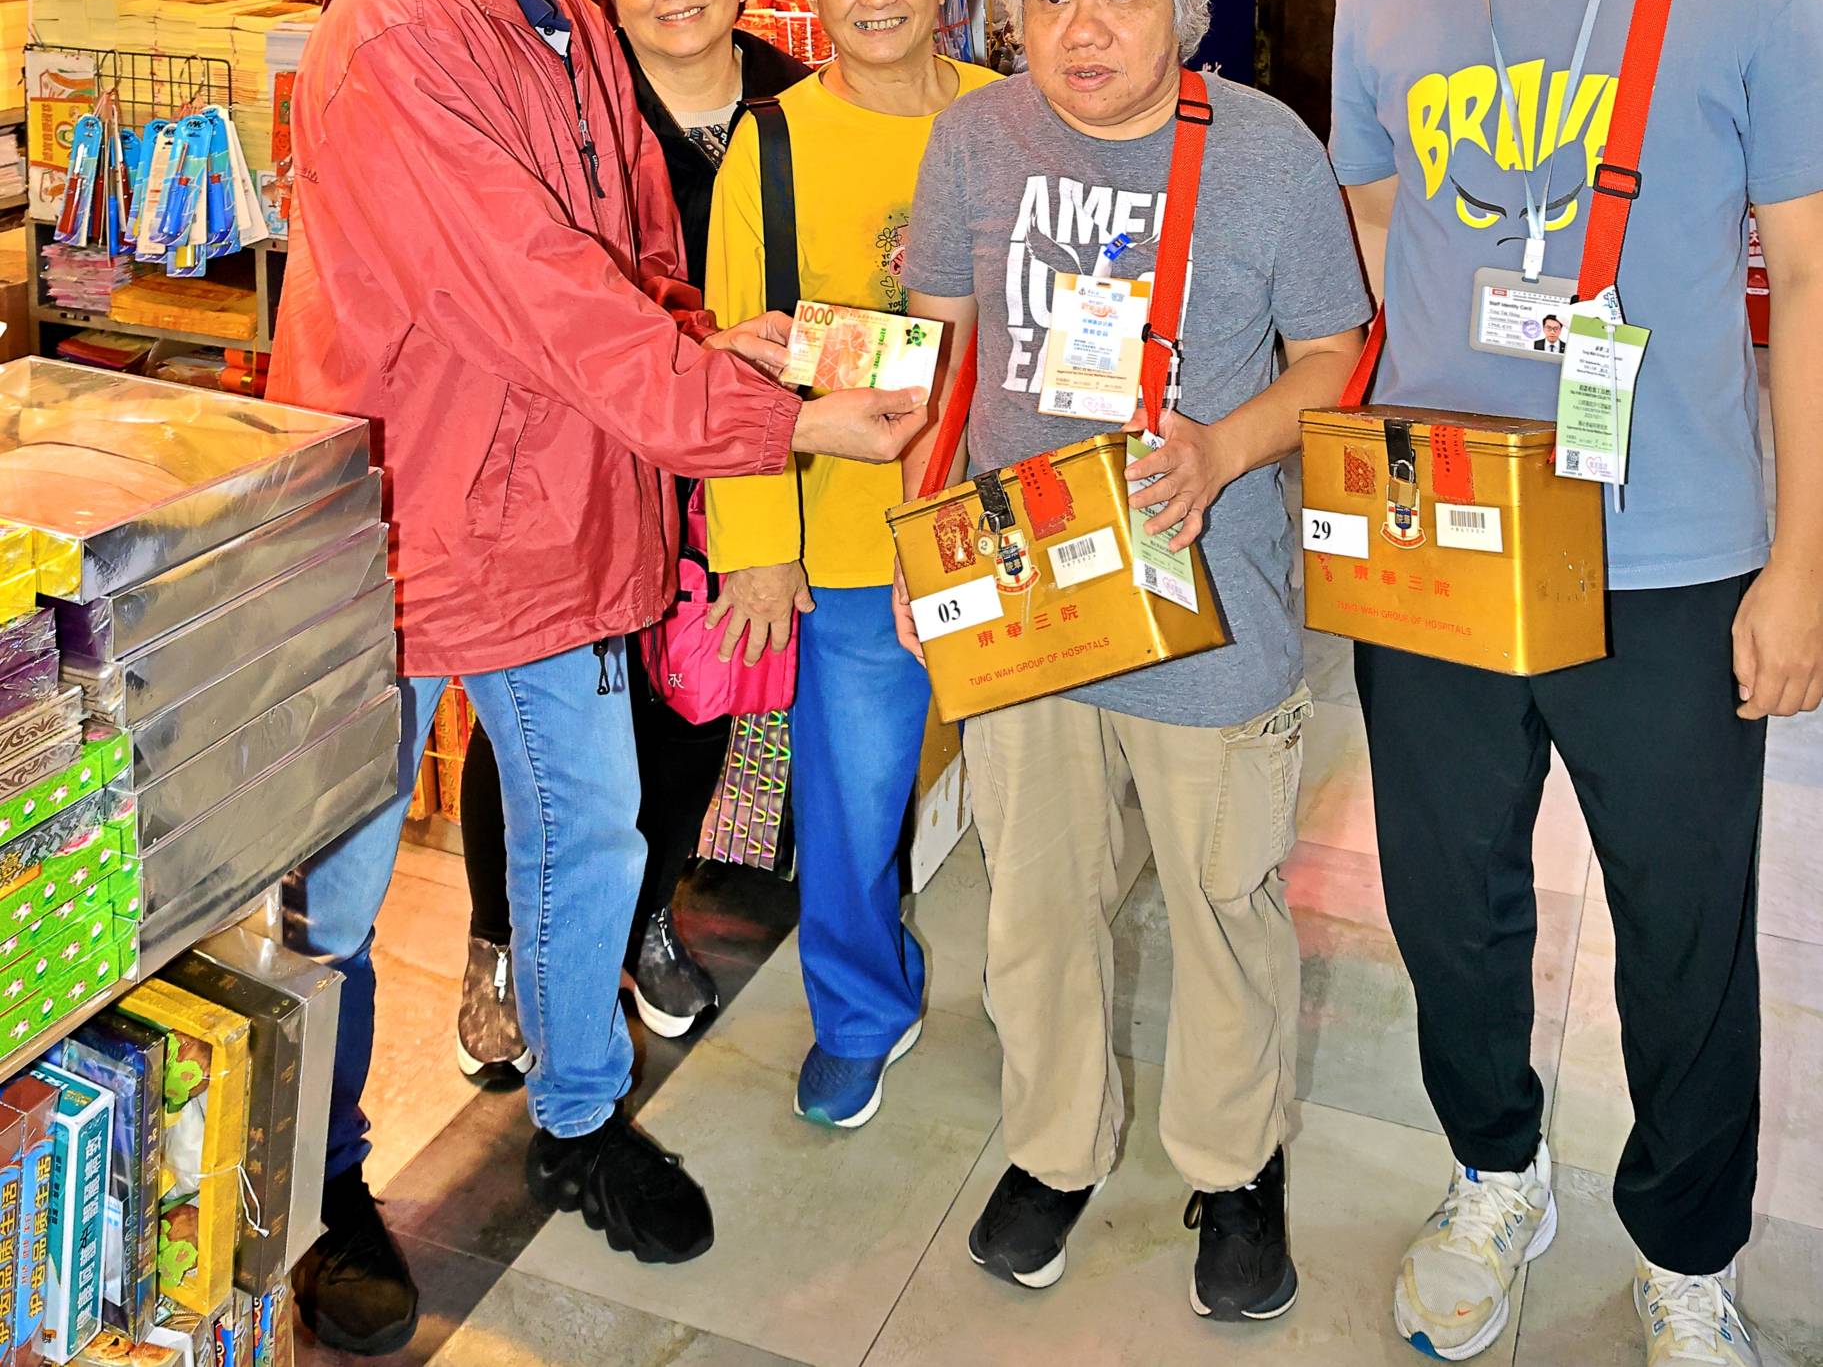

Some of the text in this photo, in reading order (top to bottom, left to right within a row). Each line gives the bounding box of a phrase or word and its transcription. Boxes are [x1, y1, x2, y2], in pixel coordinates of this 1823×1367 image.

[799, 304, 834, 326] 1000
[1311, 519, 1332, 540] 29
[1353, 564, 1450, 599] 東華三院
[938, 599, 961, 624] 03
[976, 604, 1079, 648] 東華三院
[1336, 600, 1473, 636] TUNG WAH GROUP OF HOSPITALS
[969, 637, 1110, 687] TUNG WAH GROUP OF HOSPITALS
[29, 1155, 52, 1319] 护齿品质生活
